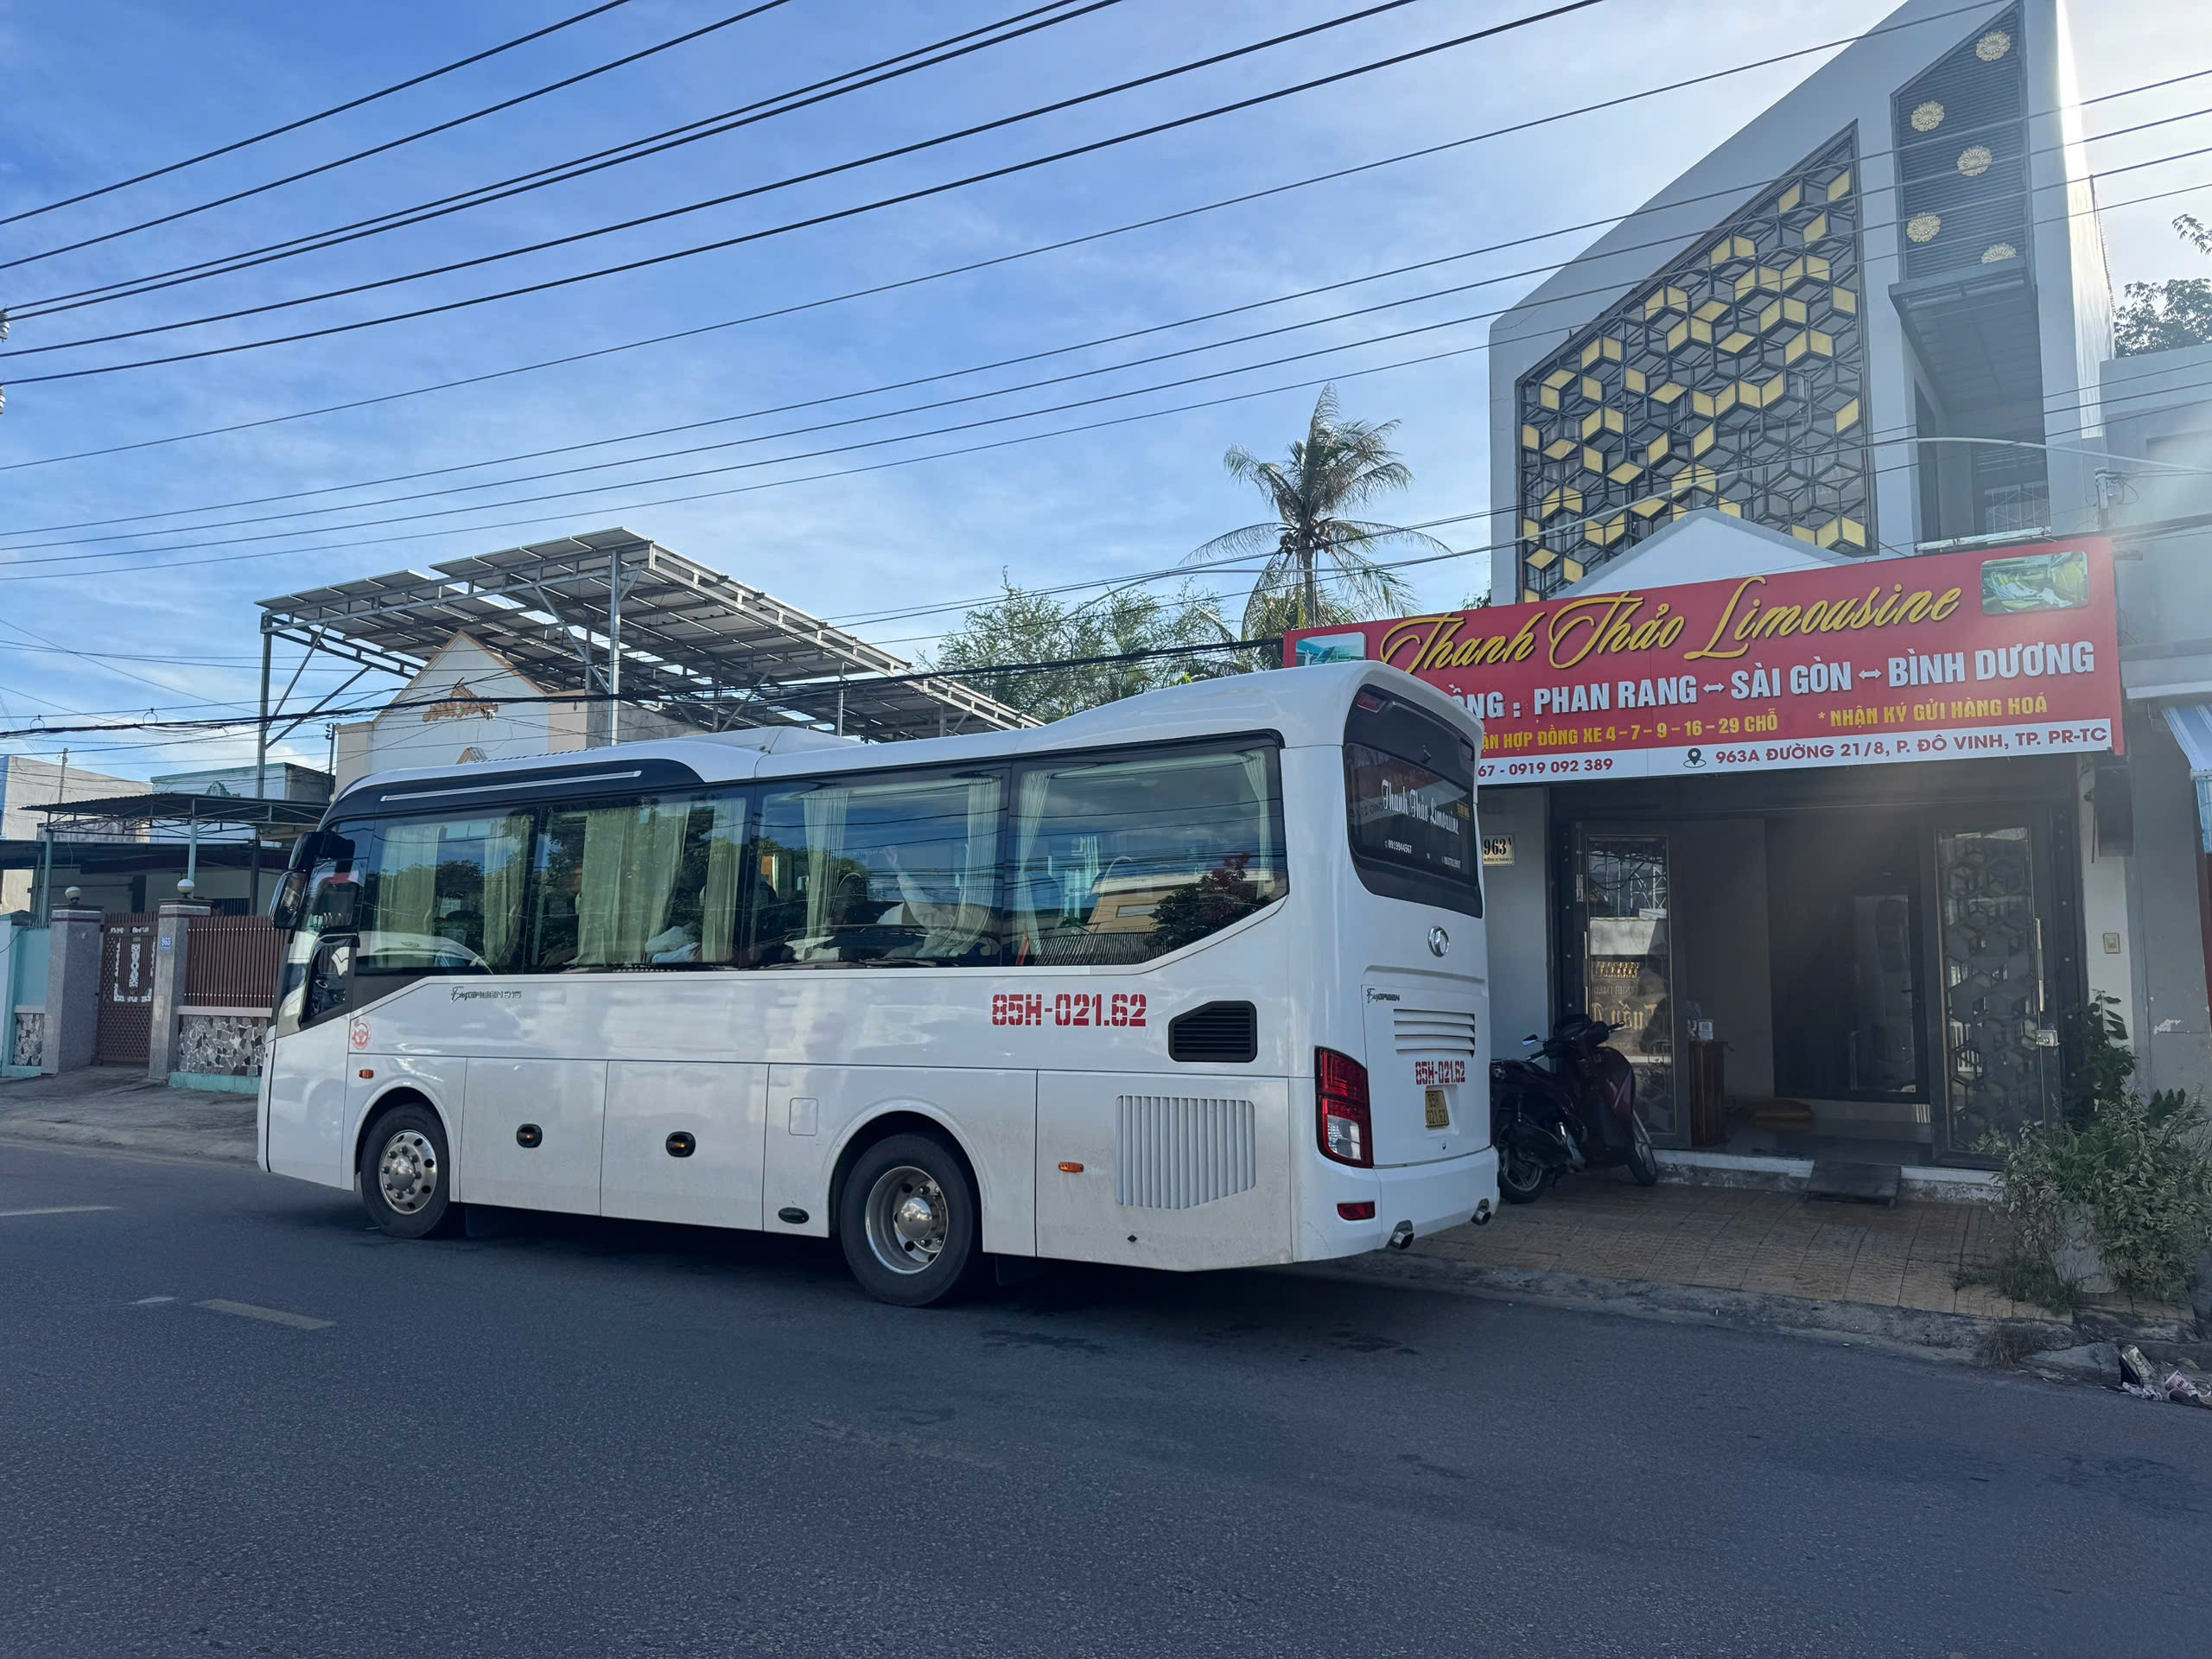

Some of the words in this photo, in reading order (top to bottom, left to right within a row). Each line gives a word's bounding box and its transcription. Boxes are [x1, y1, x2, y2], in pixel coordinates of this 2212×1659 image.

[1380, 613, 1545, 675] Thanh
[1548, 592, 1685, 669] Thảo
[1684, 576, 1962, 660] Limousine
[1534, 683, 1610, 715] PHAN
[1618, 675, 1697, 709] RANG
[1731, 662, 1781, 699] SÀI
[1789, 656, 1852, 695] GÒN
[1888, 649, 1966, 687] BÌNH
[1975, 641, 2094, 681] DƯƠNG
[1830, 705, 1878, 728] NHẬN
[1884, 702, 1907, 724] KÝ
[1913, 698, 1946, 721] GỬI
[1951, 696, 2002, 719] HÀNG
[2008, 692, 2048, 715] HOÁ
[1503, 731, 1534, 751] HỢP
[1538, 724, 1579, 747] ĐỒNG
[1583, 727, 1602, 744] XE
[1745, 708, 1778, 733] CHỖ
[1715, 749, 1761, 765] 963A
[1766, 743, 1834, 762] ĐƯỜNG
[1897, 740, 1910, 754] P.
[1917, 734, 1948, 753] ĐÔ
[1954, 734, 2009, 751] VINH,
[2015, 732, 2042, 747] TP.
[2049, 728, 2108, 745] PR-TC
[1509, 762, 1547, 775] 0919
[1550, 760, 1579, 773] 092
[1584, 758, 1613, 771] 389
[992, 994, 1147, 1027] 85H-021.62
[1415, 1060, 1465, 1085] 85H-021.62
